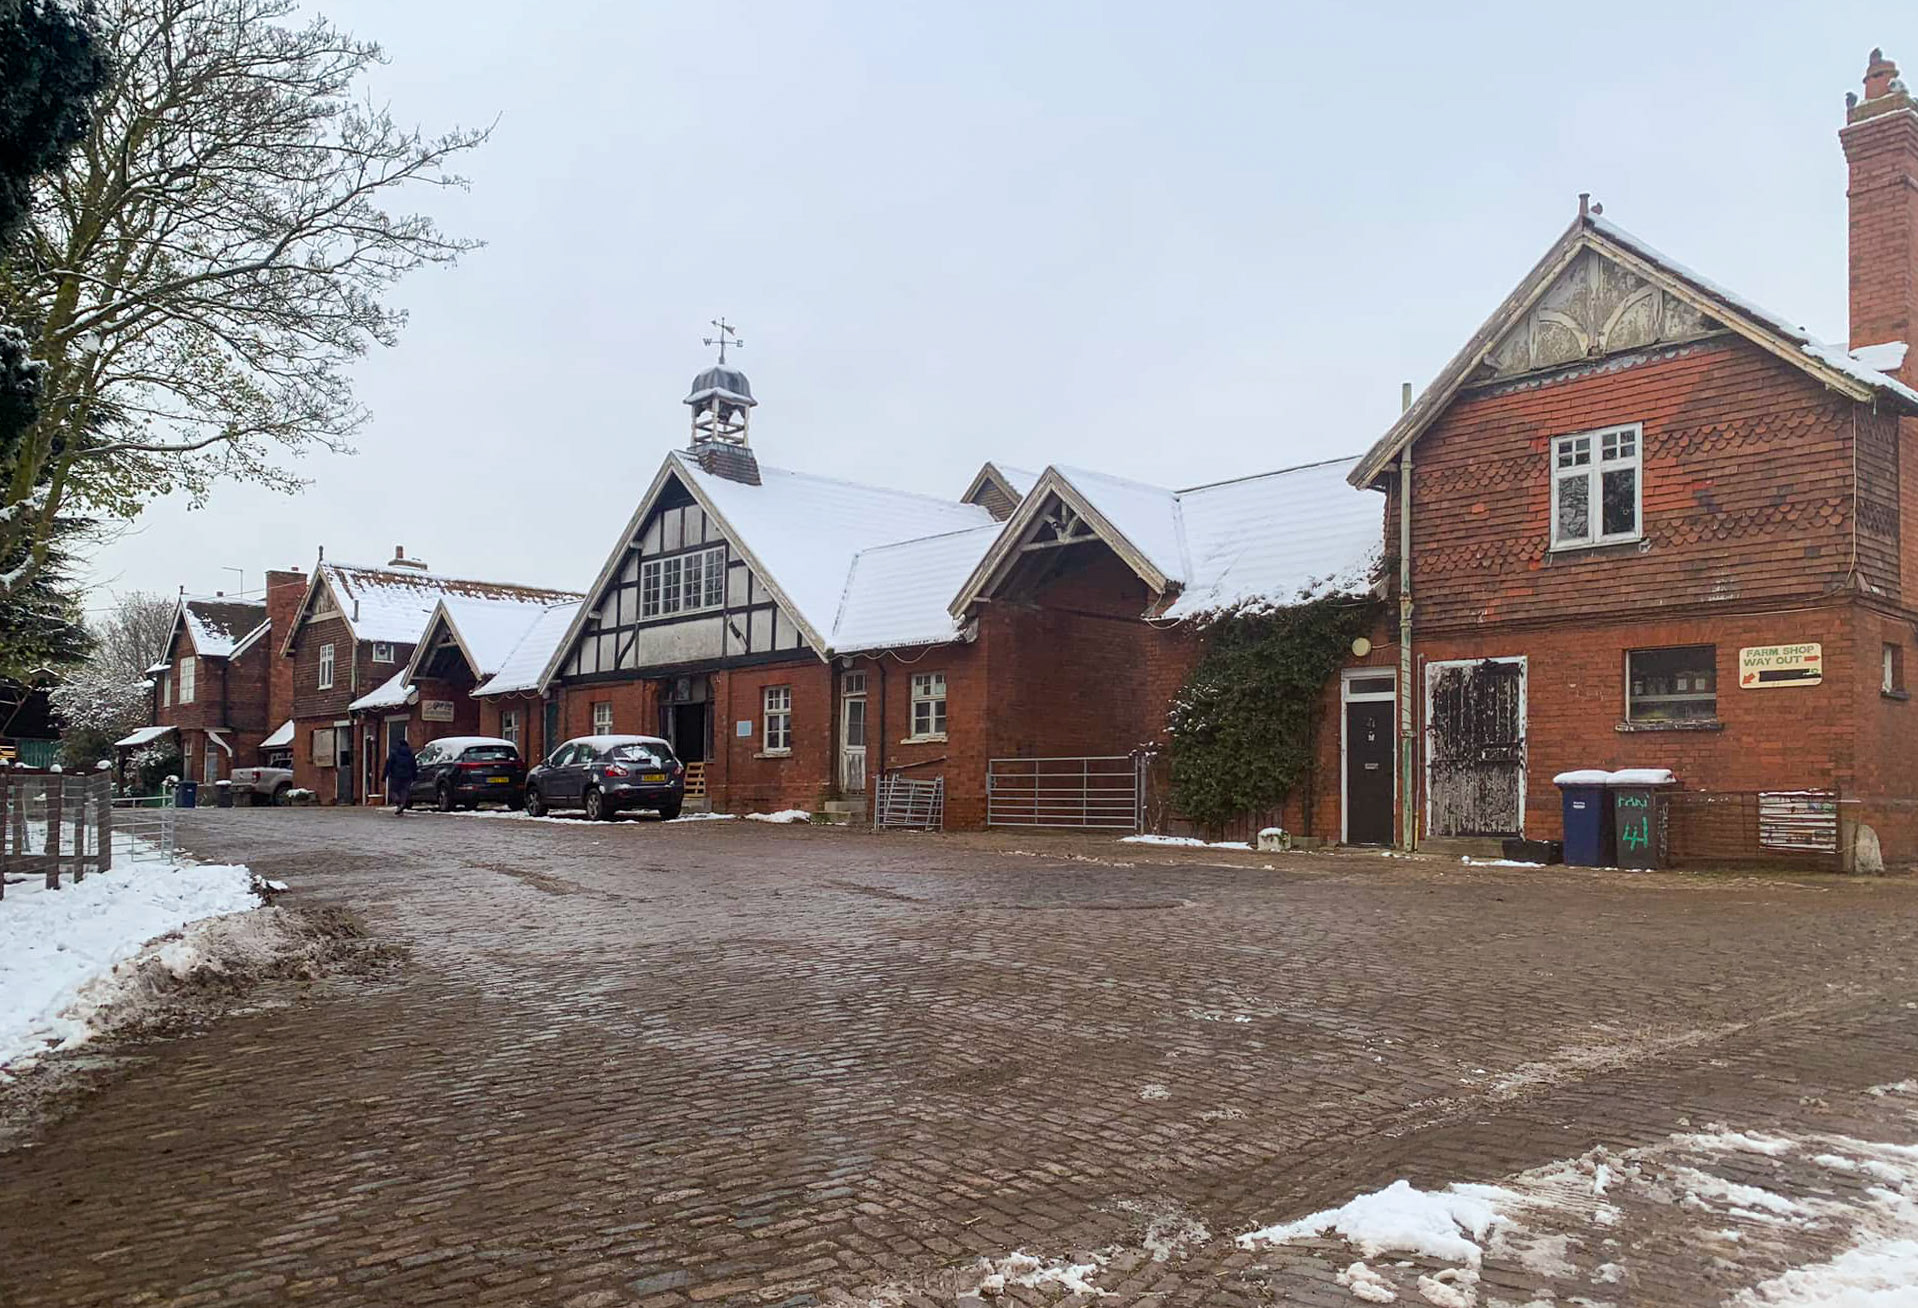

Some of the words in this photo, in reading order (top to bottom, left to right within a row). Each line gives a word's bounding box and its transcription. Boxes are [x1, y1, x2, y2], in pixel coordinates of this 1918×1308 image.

[1746, 648, 1778, 657] FARM
[1783, 645, 1814, 655] SHOP
[1744, 657, 1771, 666] WAY
[1776, 655, 1802, 665] OUT
